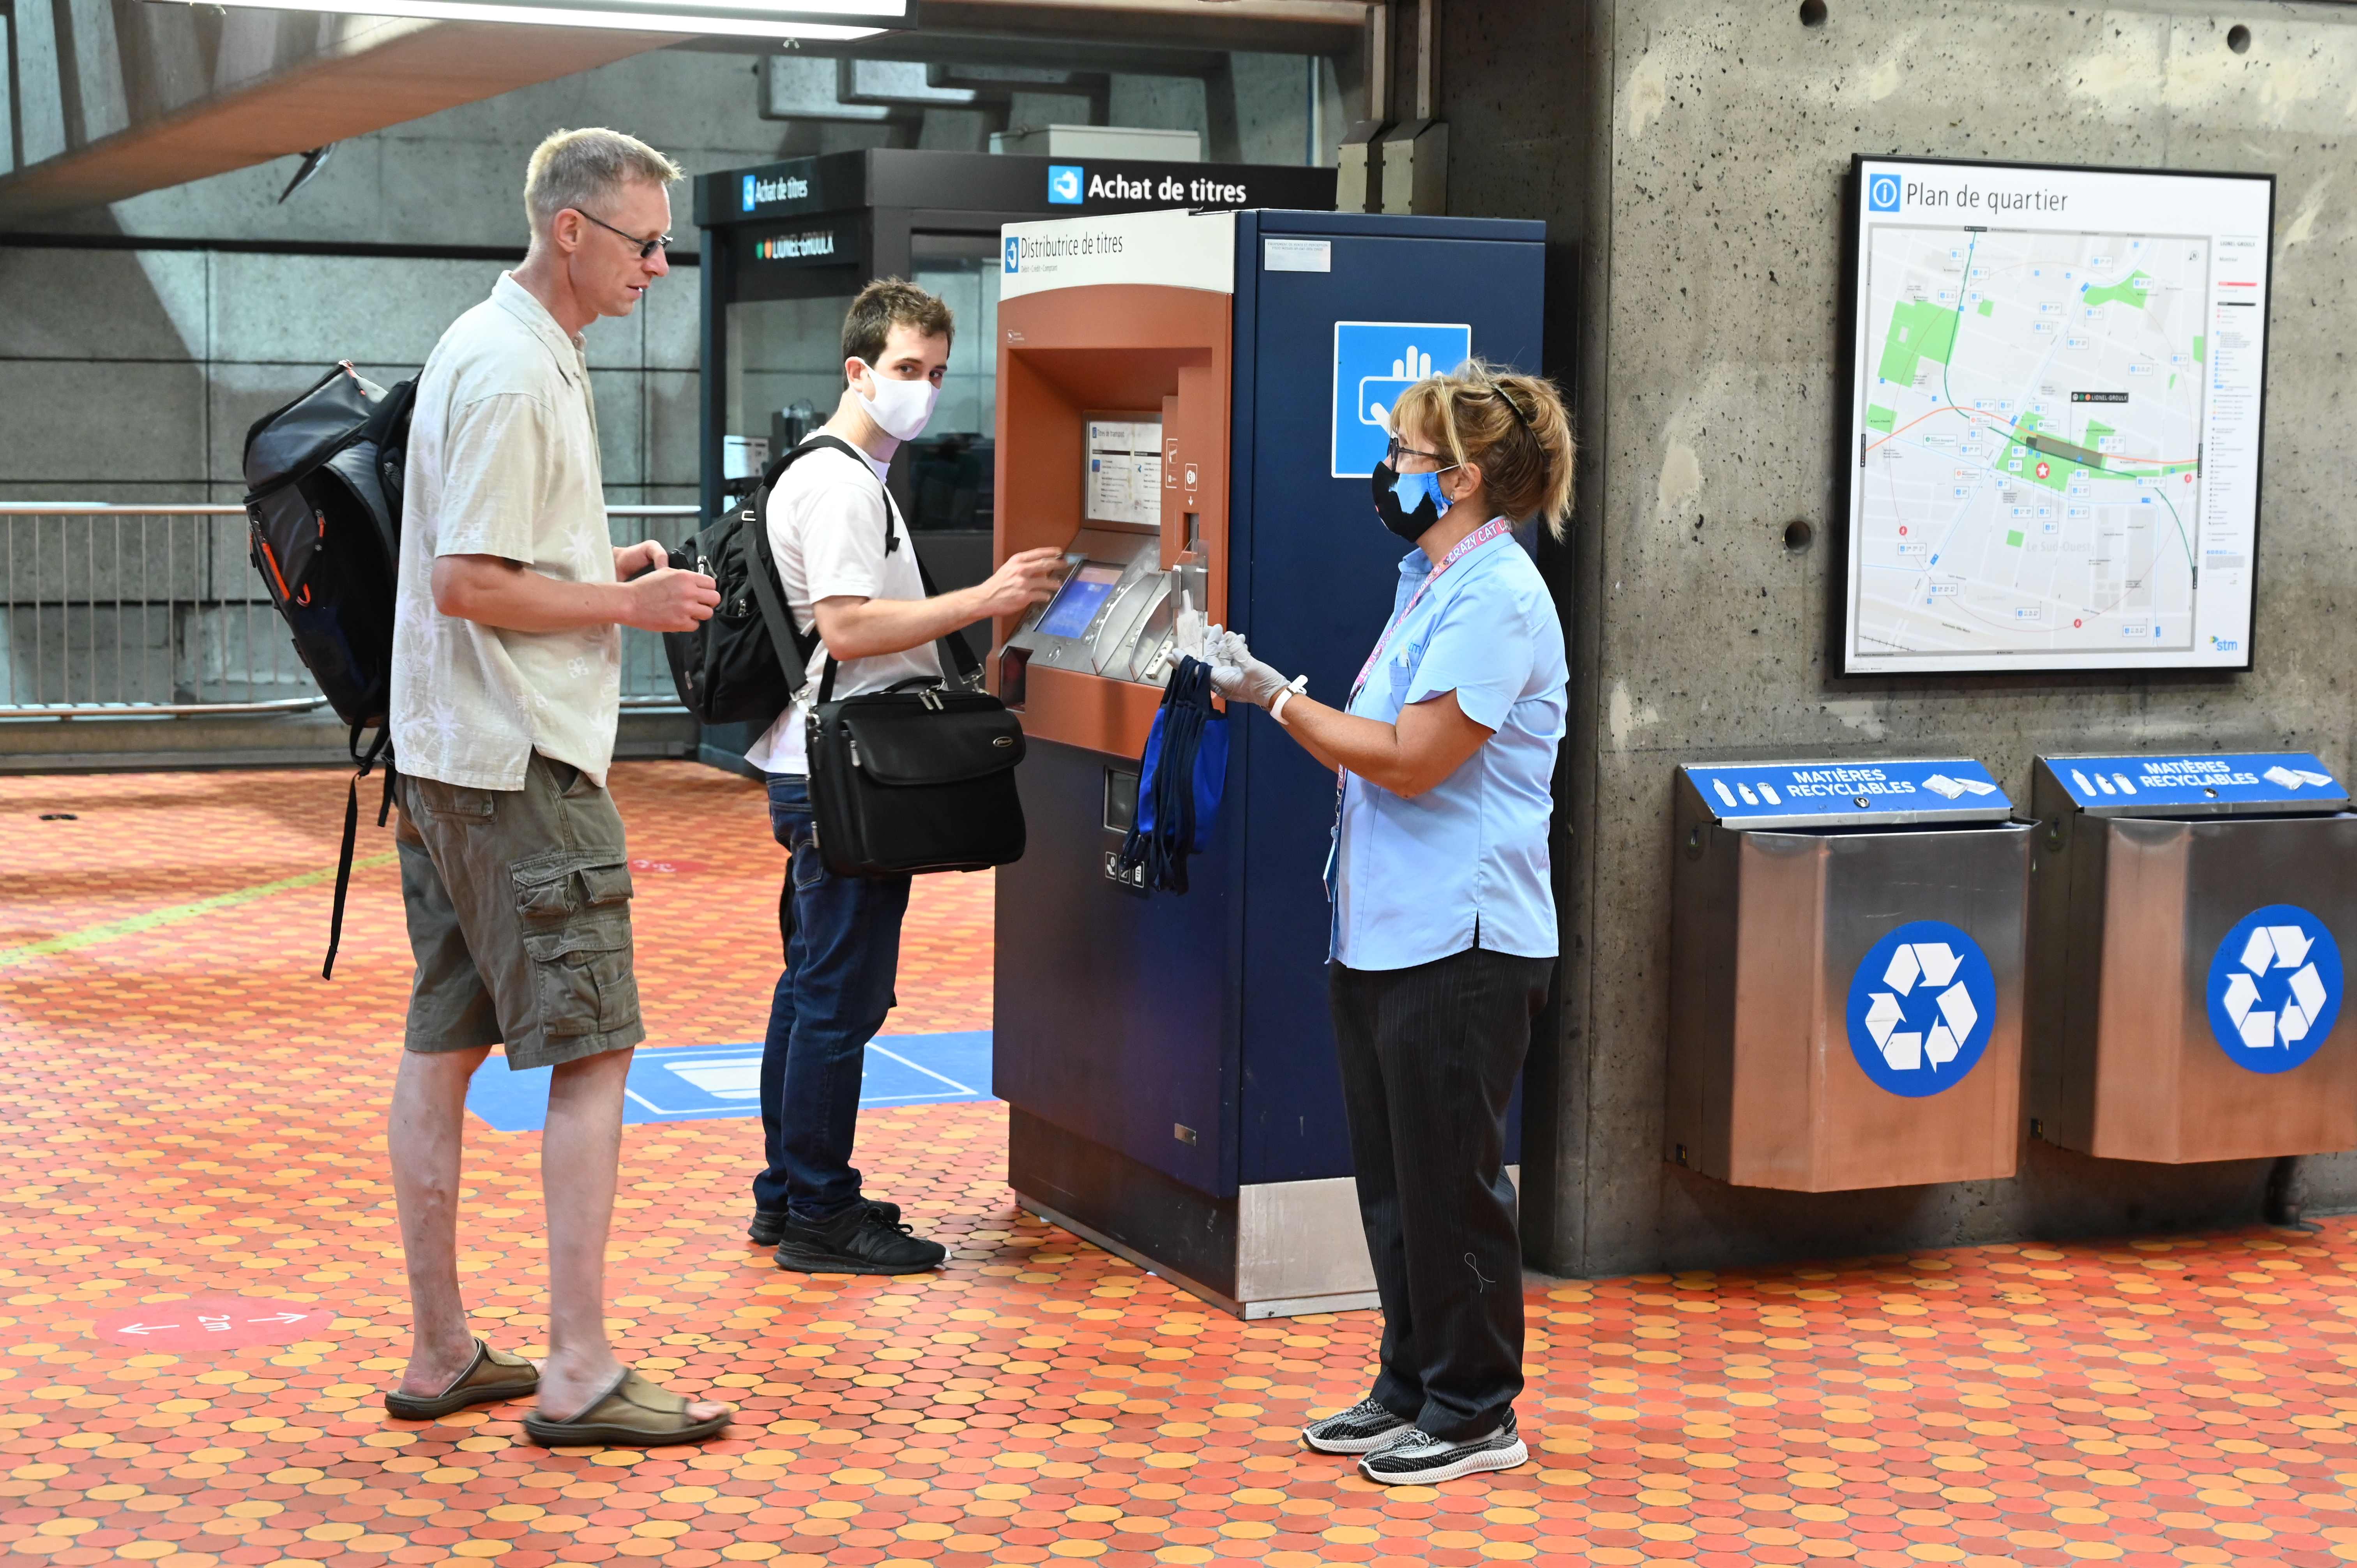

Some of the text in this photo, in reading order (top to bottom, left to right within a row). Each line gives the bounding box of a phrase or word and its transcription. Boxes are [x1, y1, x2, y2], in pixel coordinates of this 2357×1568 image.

[755, 176, 808, 202] Achat de titres
[1088, 174, 1247, 203] Achat de titres
[1907, 182, 2069, 214] Plan de quartier
[1021, 231, 1123, 258] Distributrice de titres
[1449, 534, 1477, 562] CRAZY
[1478, 523, 1497, 542] CAT
[2027, 540, 2092, 553] Le Sud-Ouest
[2217, 639, 2237, 651] stm
[1792, 768, 1886, 783] MATIÈRES
[2143, 760, 2230, 774] MATIÈRES
[1786, 781, 1916, 797] RECYCLABLES
[2139, 772, 2260, 787] RECYCLABLES
[846, 1231, 880, 1255] N
